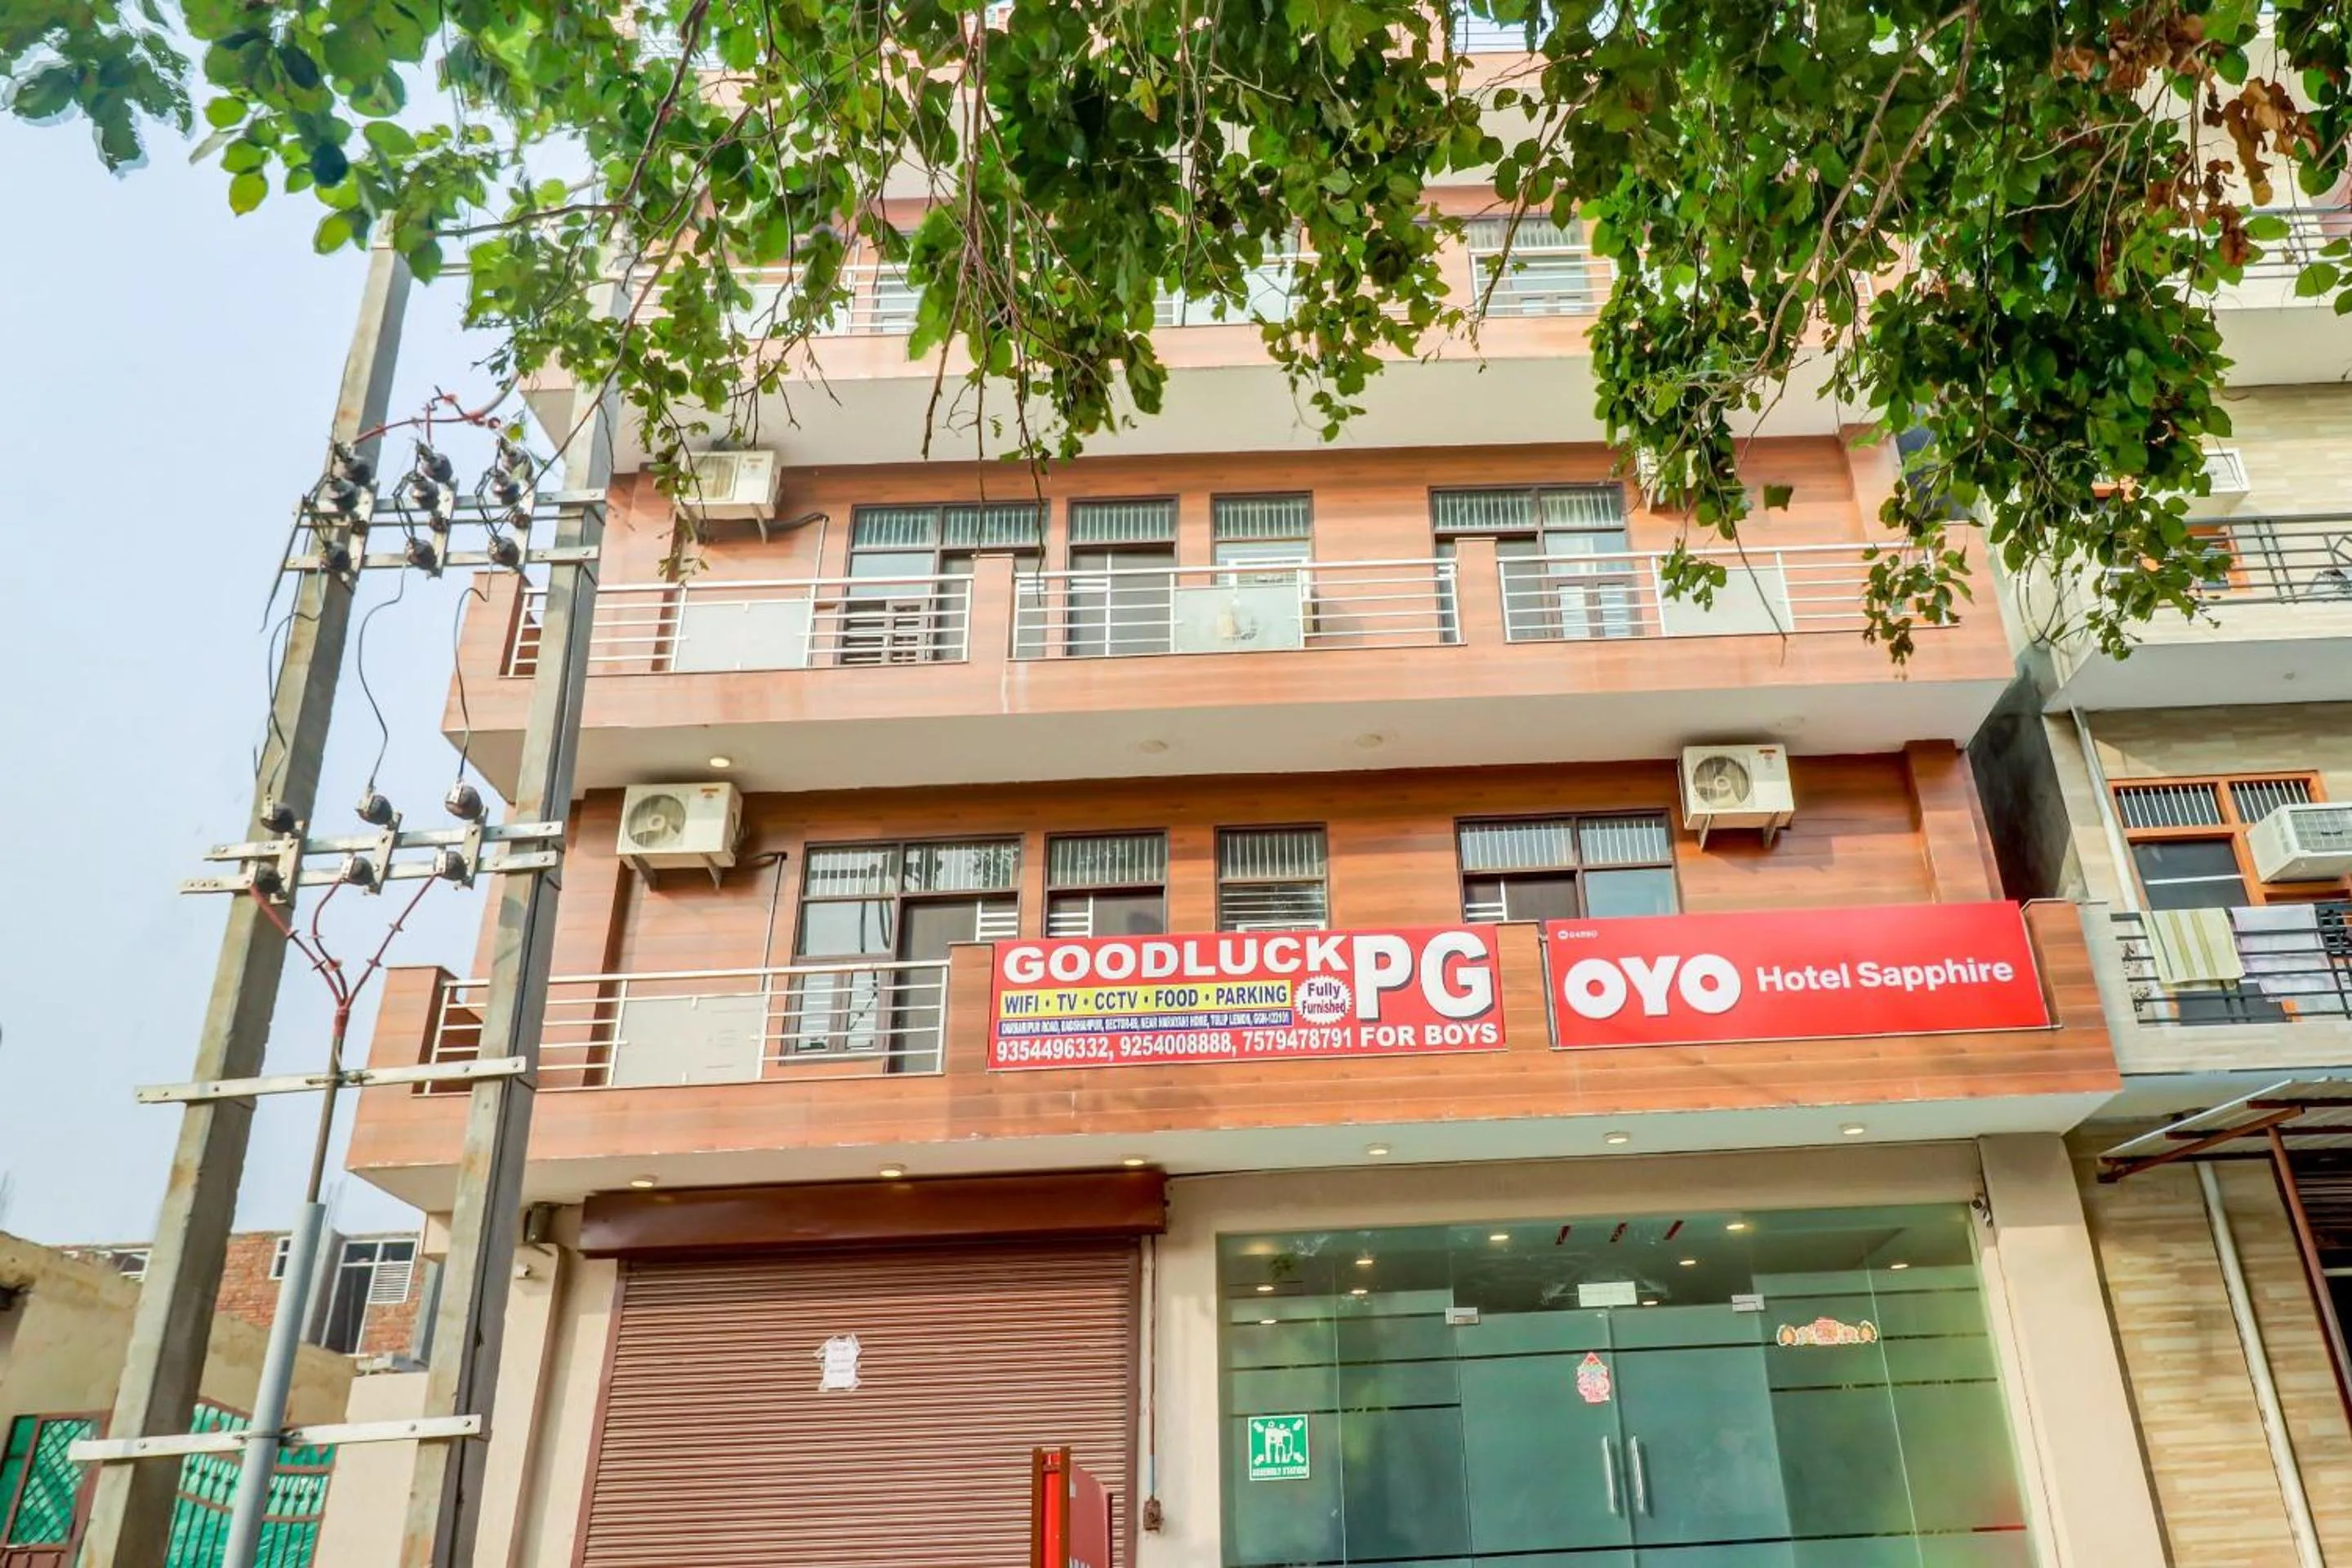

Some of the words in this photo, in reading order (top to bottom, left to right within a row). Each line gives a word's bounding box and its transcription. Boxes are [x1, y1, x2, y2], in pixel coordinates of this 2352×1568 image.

[1003, 935, 1349, 983] GOODLUCK
[1352, 931, 1494, 1021] PG
[1757, 962, 1851, 991] Hotel
[1857, 957, 2014, 991] Sapphire
[1004, 995, 1039, 1013] WIFI
[1057, 993, 1077, 1011] TV
[1094, 991, 1138, 1009] CCTV
[1155, 988, 1198, 1008] FOOD
[1216, 985, 1287, 1005] PARKING
[1307, 982, 1340, 1000] Fully
[1564, 953, 1742, 1019] OYO
[1302, 998, 1347, 1014] Furnished
[996, 1036, 1114, 1062] 9354496332,
[1120, 1032, 1236, 1058] 9254008888,
[1242, 1027, 1352, 1052] 7579478791
[1360, 1025, 1416, 1048] FOR
[1424, 1022, 1499, 1045] BOYS
